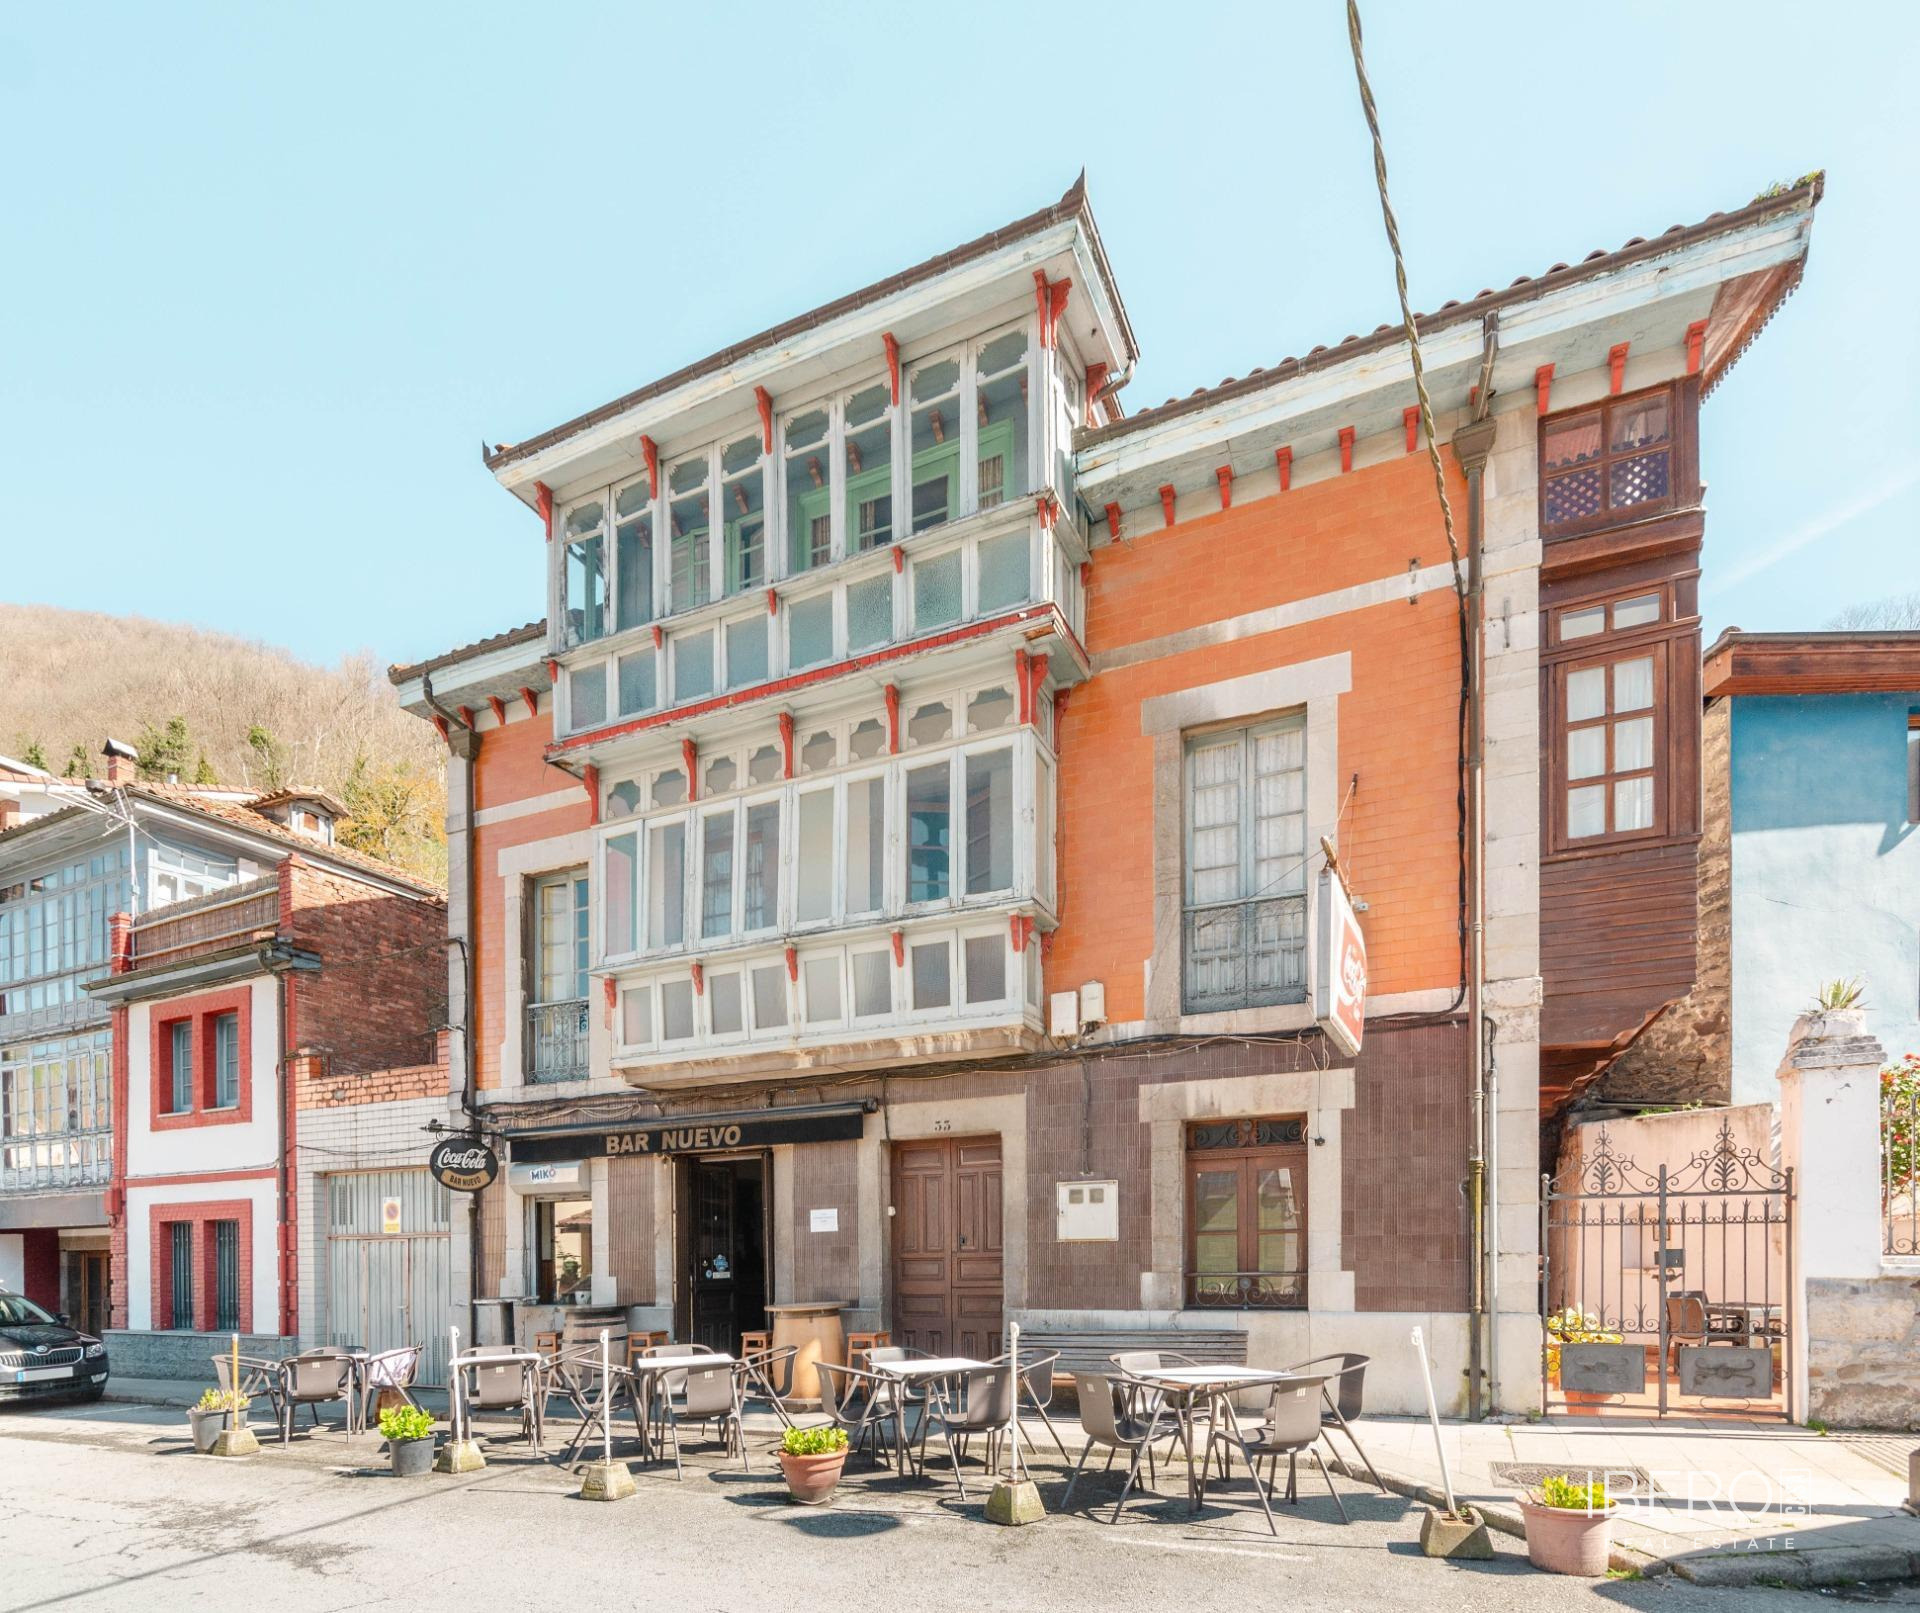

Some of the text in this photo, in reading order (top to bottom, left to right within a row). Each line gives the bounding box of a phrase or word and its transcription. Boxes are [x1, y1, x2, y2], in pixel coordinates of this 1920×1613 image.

[606, 1125, 741, 1154] BAR NUEVO
[531, 1168, 556, 1180] MIKO
[450, 1175, 482, 1187] BAR NUEVO
